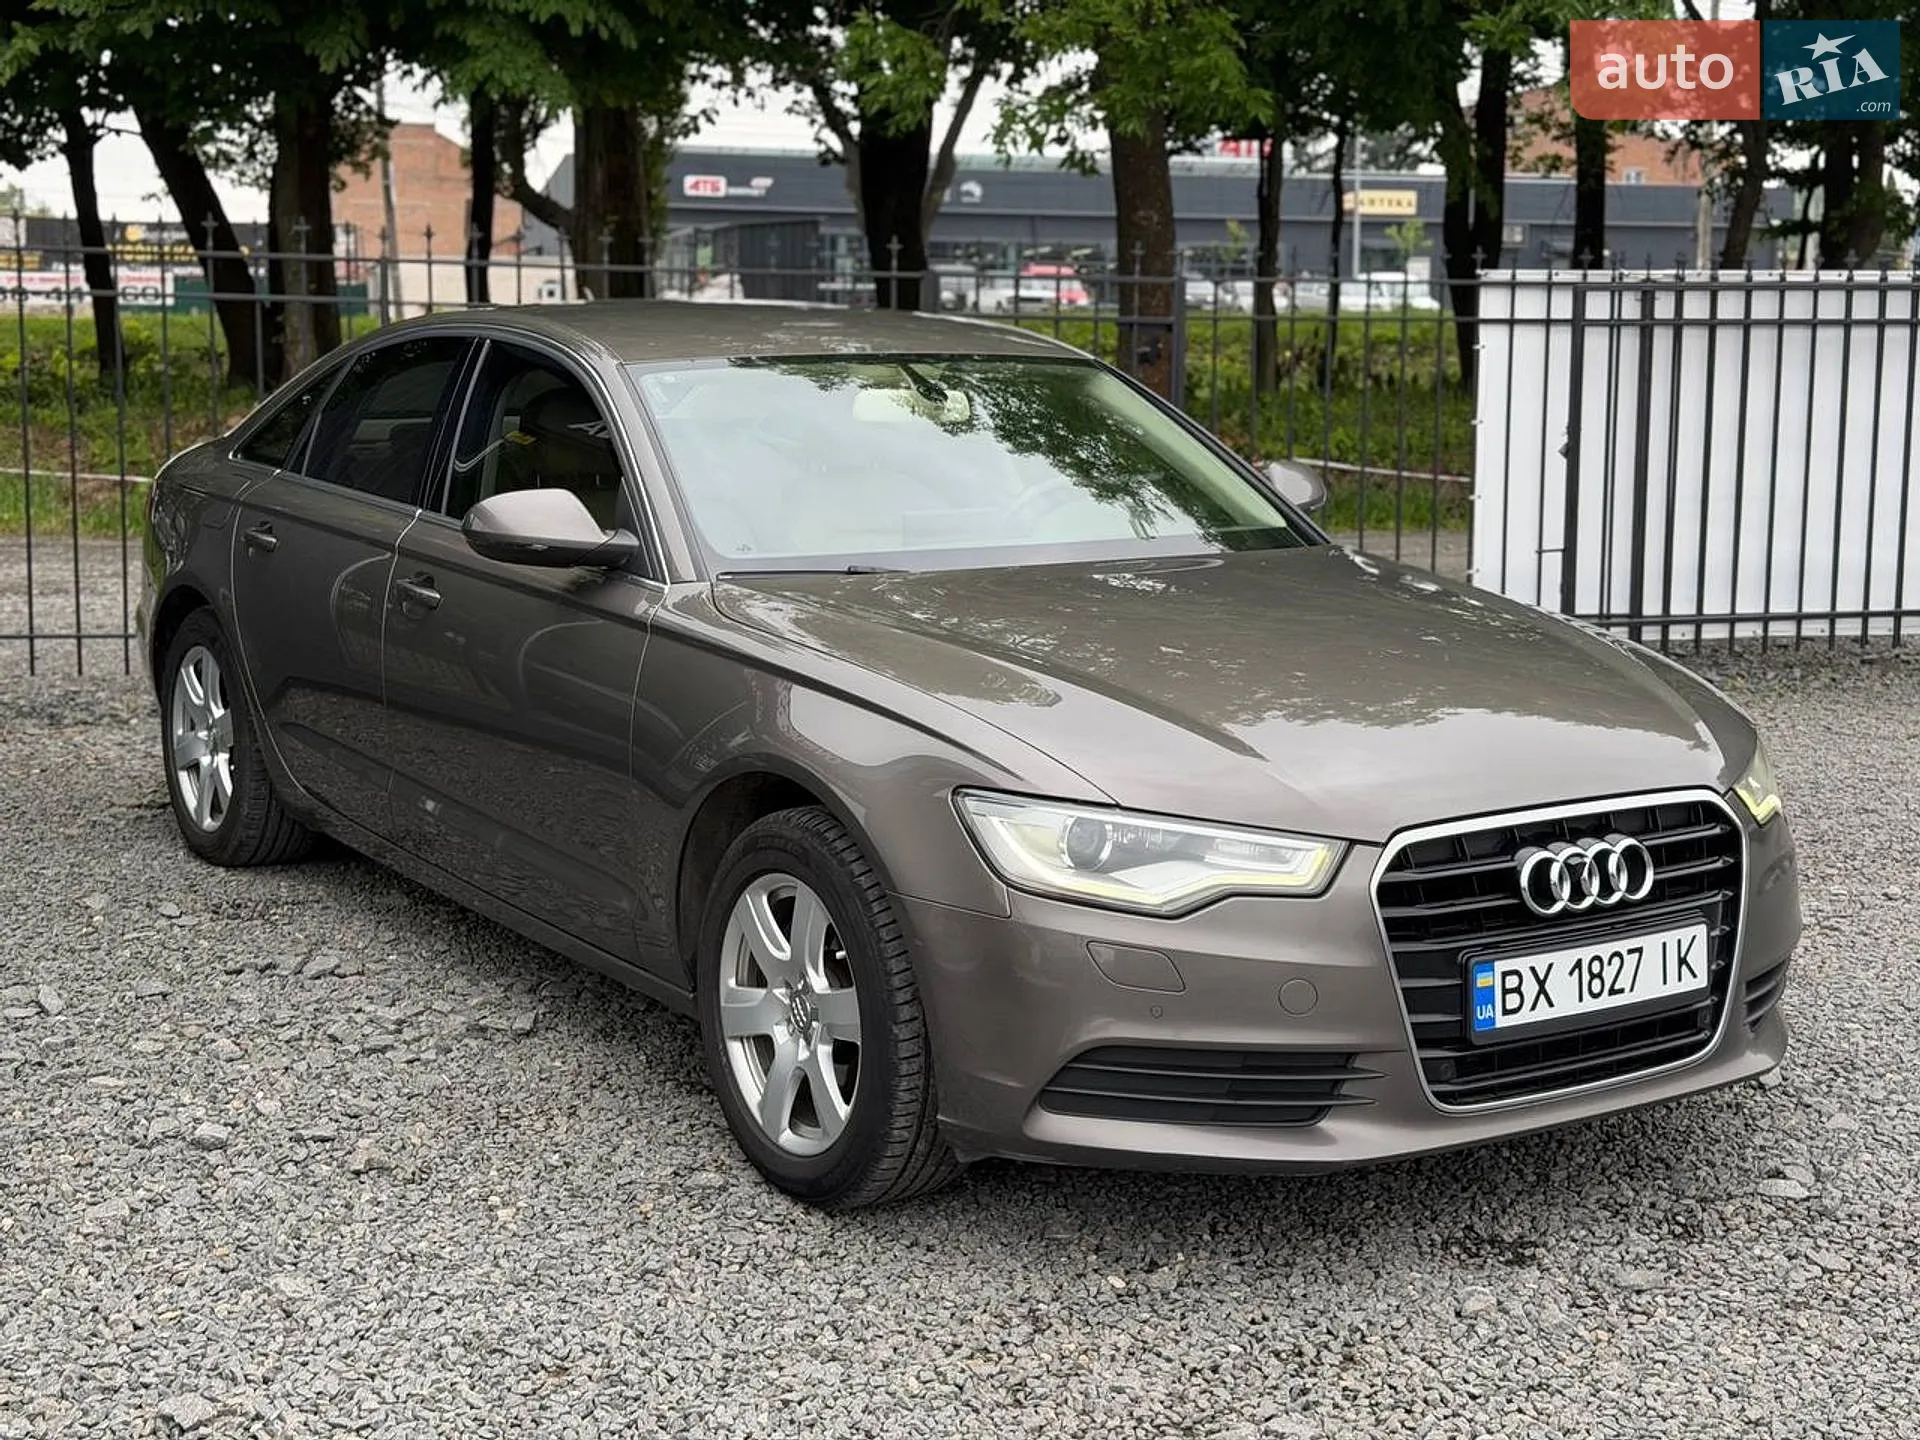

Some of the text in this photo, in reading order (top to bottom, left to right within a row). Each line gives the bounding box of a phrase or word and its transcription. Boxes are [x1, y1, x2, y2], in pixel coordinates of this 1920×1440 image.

[1500, 934, 1698, 1017] BX 1827 IK
[1476, 1003, 1495, 1020] UA
